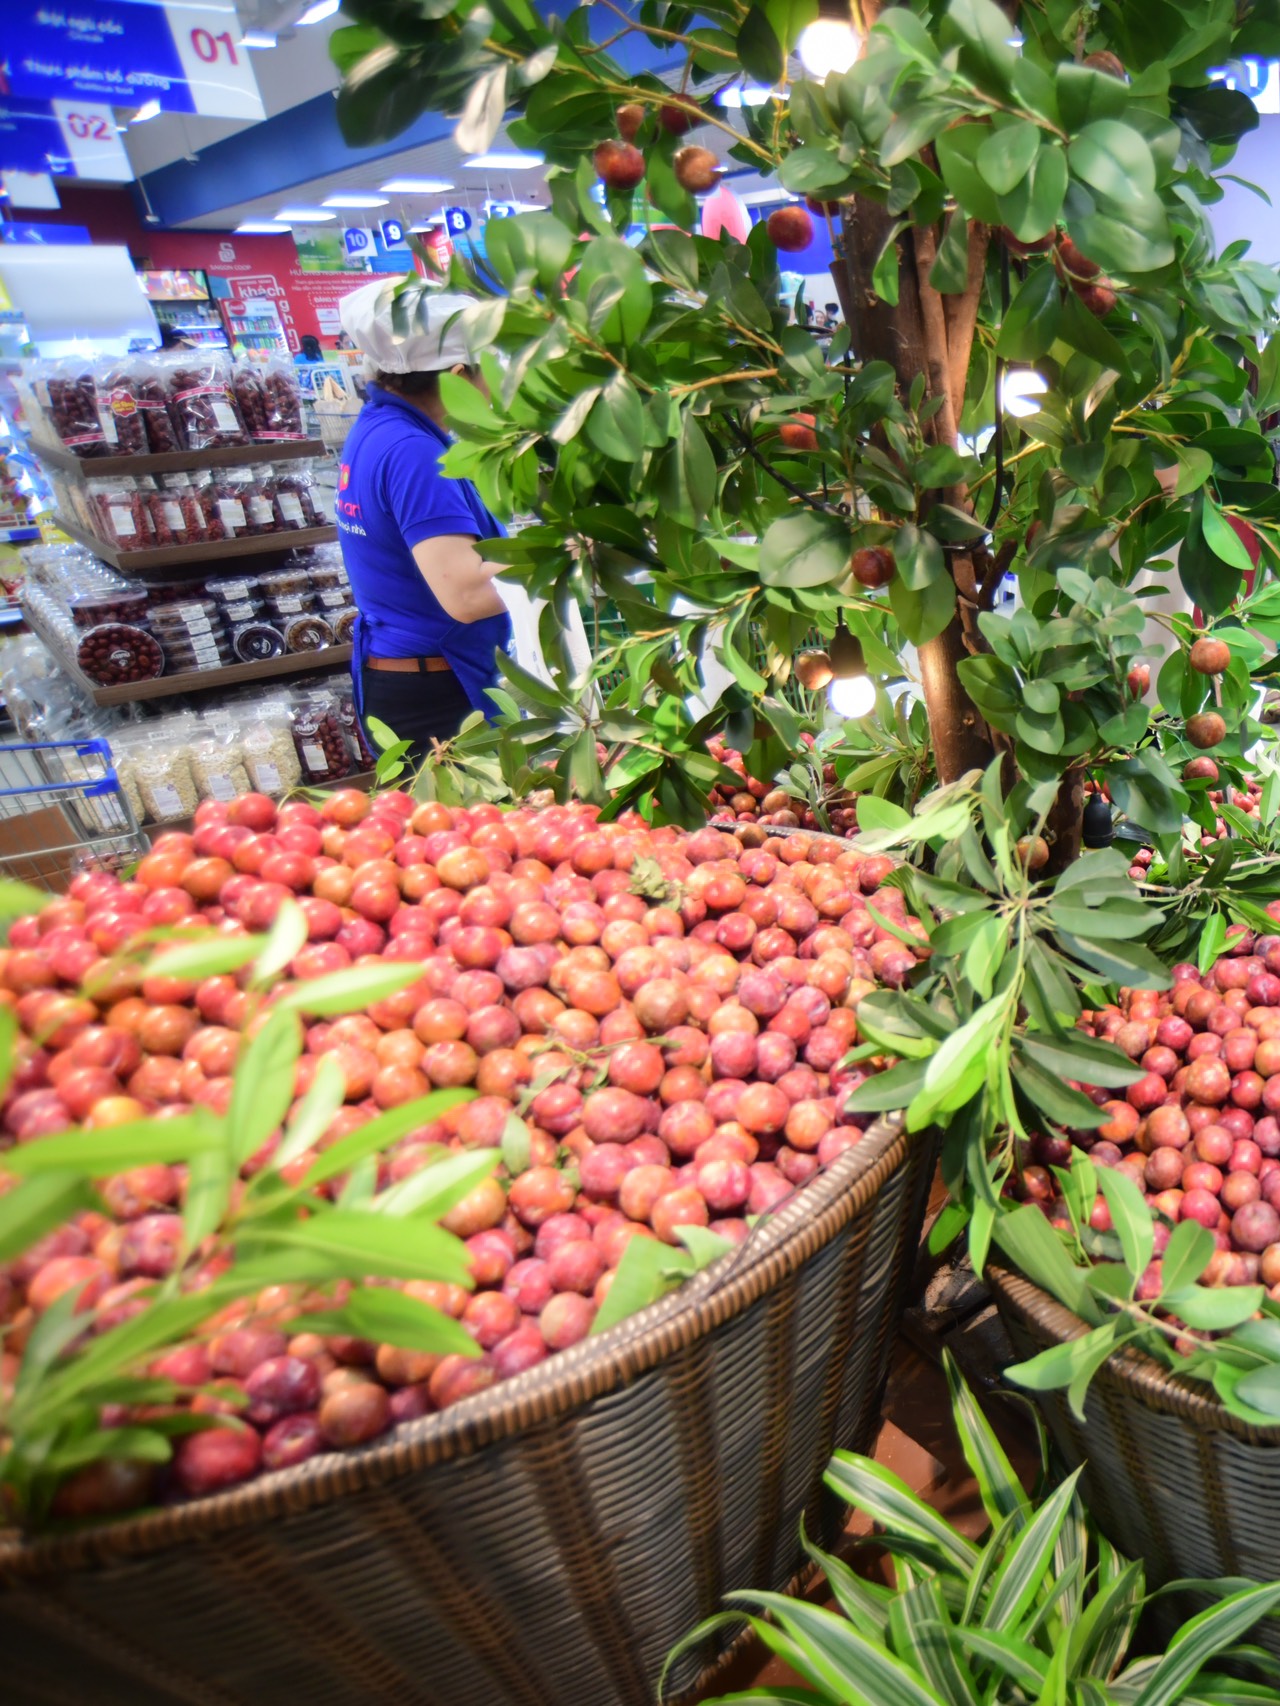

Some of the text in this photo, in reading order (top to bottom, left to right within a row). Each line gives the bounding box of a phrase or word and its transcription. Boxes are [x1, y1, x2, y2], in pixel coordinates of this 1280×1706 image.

[191, 27, 239, 66] 01
[67, 113, 112, 141] 02
[452, 212, 466, 229] 8
[349, 233, 366, 247] 10
[388, 224, 402, 240] 9
